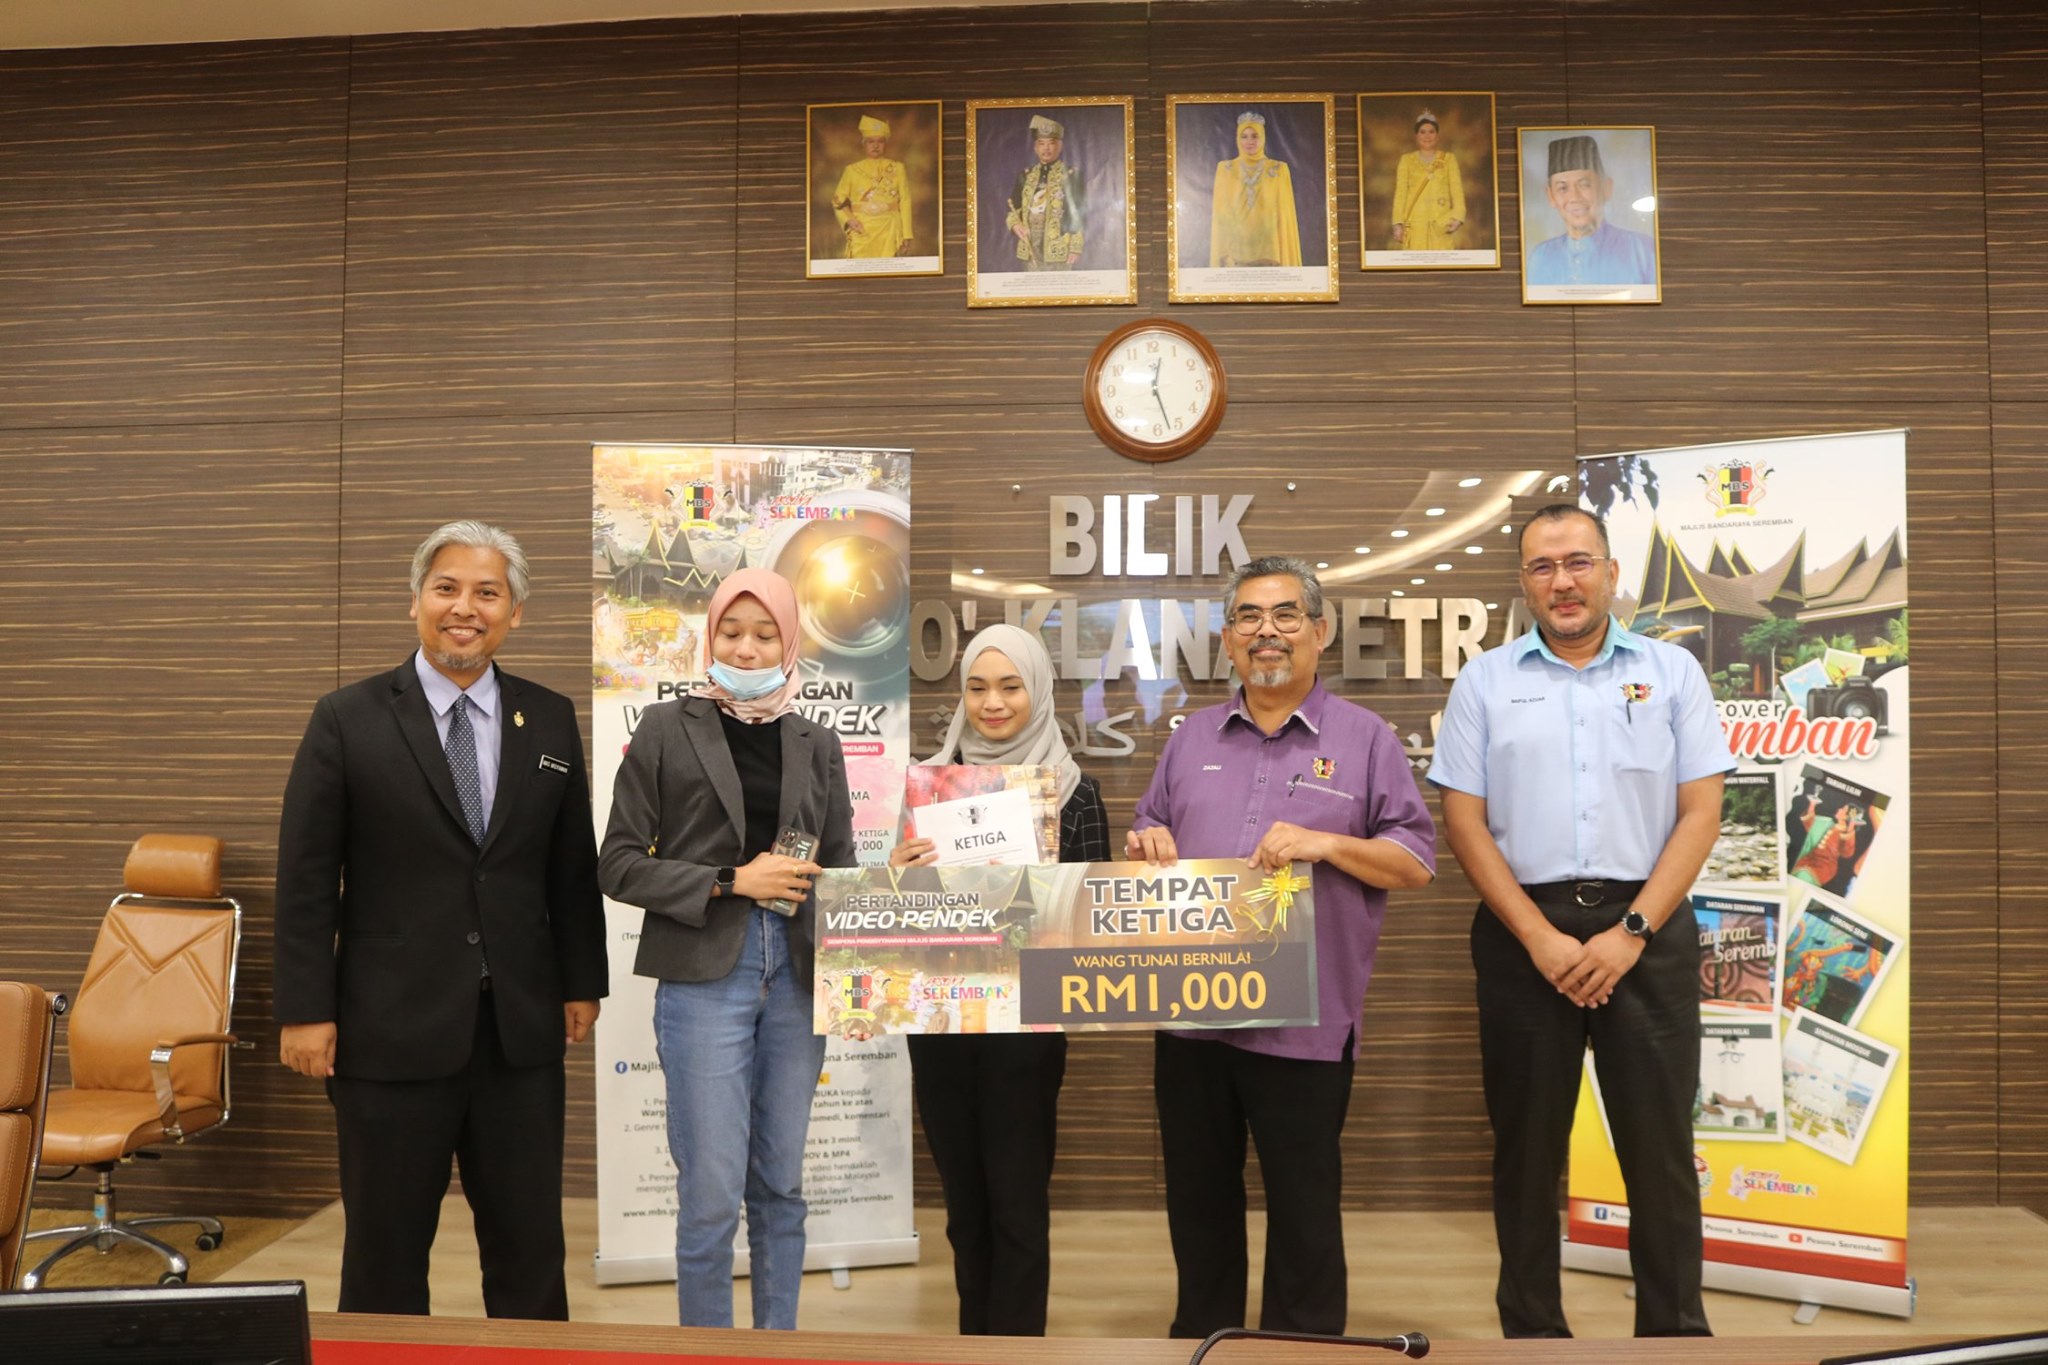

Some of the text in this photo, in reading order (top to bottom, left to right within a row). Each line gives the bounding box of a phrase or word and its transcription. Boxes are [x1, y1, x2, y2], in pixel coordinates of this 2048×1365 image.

[1721, 482, 1749, 491] MBS
[686, 500, 711, 508] MBS
[770, 506, 855, 520] SEREMBAN
[1050, 495, 1254, 576] BILIK
[910, 600, 977, 681] O'
[1005, 599, 1233, 680] KLAN
[1716, 703, 1783, 717] over
[842, 745, 879, 753] REMBAN
[954, 831, 1007, 850] KETIGA
[1086, 876, 1237, 903] TEMPAT
[847, 893, 979, 908] PERTANDINGAN
[825, 909, 1000, 930] VIDEO PENDEK
[1093, 907, 1235, 934] KETIGA
[1073, 952, 1251, 968] WANG TUNAI BERNILAI
[844, 989, 870, 997] MBS
[923, 987, 1009, 1000] SEREMBAN
[1061, 970, 1267, 1019] RM1,000
[844, 1051, 897, 1061] Seremban
[841, 1088, 871, 1098] kepada
[844, 1111, 890, 1120] komentari
[807, 1197, 848, 1206] andaraya
[850, 1194, 894, 1203] Seremban
[1807, 1236, 1836, 1247] Pesona
[1838, 1241, 1883, 1253] Seremban
